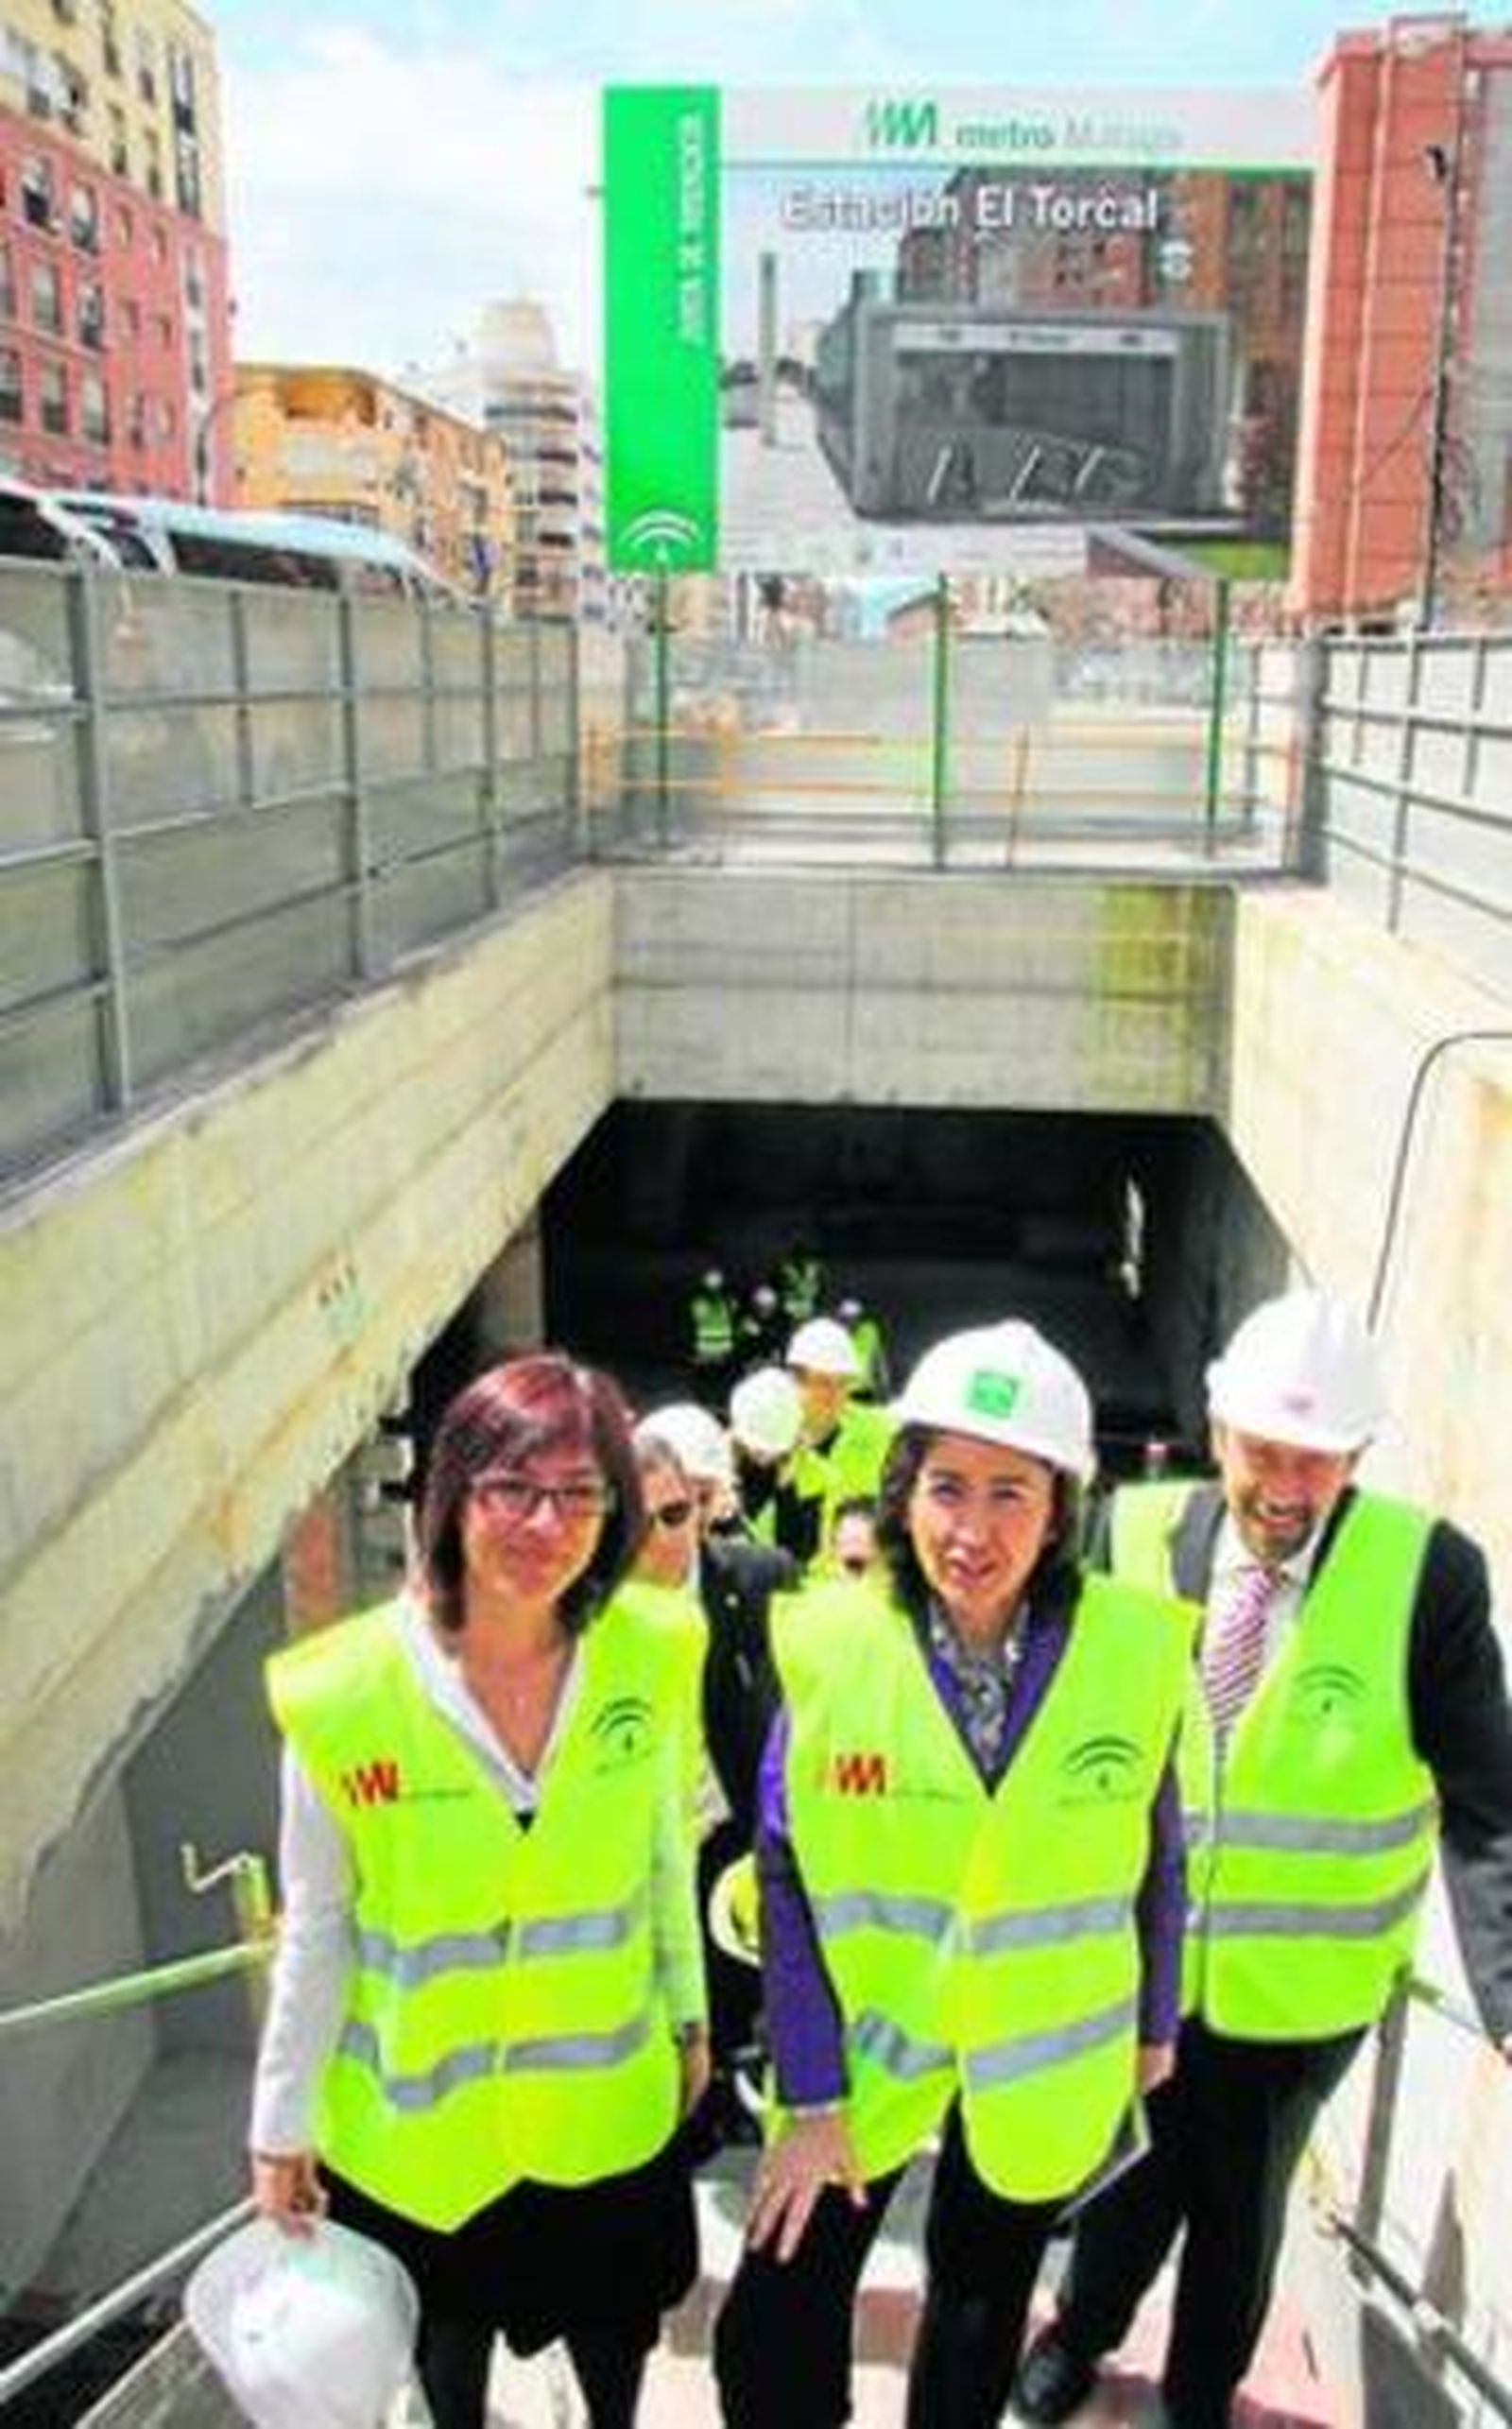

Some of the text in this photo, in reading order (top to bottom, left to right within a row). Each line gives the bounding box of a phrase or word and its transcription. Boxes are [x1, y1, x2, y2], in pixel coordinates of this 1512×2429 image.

[955, 118, 1056, 147] metro
[783, 187, 1159, 230] Estación El Torcal
